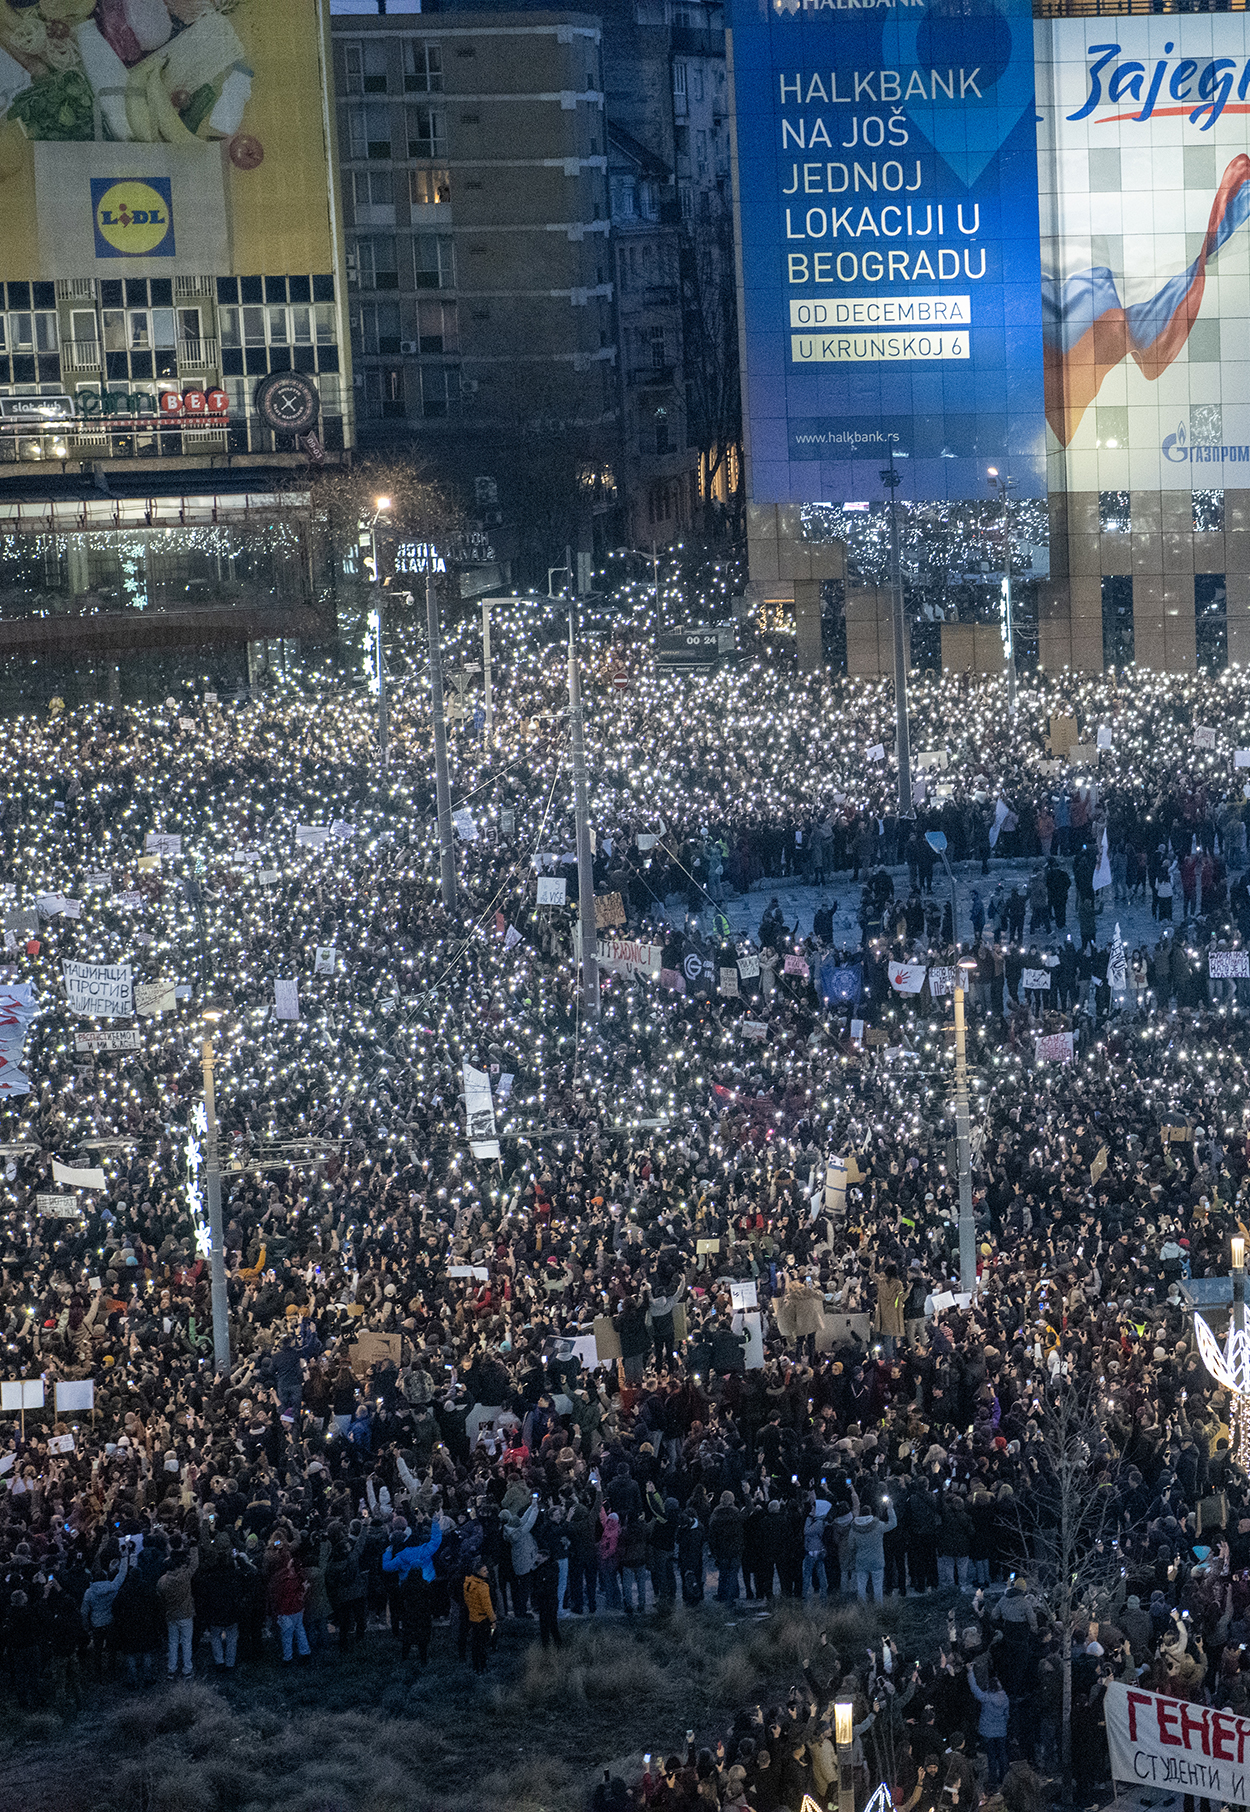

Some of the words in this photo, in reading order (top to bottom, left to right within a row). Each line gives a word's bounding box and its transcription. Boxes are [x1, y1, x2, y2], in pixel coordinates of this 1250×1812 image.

[780, 68, 982, 104] HALKBANK
[782, 118, 832, 149] NA
[842, 106, 909, 147] JOŠ
[782, 160, 922, 194] JEDNOJ
[786, 204, 943, 238] LOKACIJI
[957, 203, 979, 234] U
[788, 248, 986, 283] BEOGRADU
[798, 305, 827, 323] OD
[836, 302, 963, 323] DECEMBRA
[799, 340, 813, 358] U
[822, 338, 943, 358] KRUNSKOJ
[951, 337, 962, 355] 6
[795, 431, 900, 444] www.halkbank.rs
[1189, 445, 1250, 463] ГАЗПРОМ
[69, 979, 130, 999] ПРОТИВ
[69, 994, 131, 1015] АШИНЕРИЈЕ
[1134, 1750, 1220, 1791] СТУДЕНТИ
[1232, 1772, 1246, 1800] И
